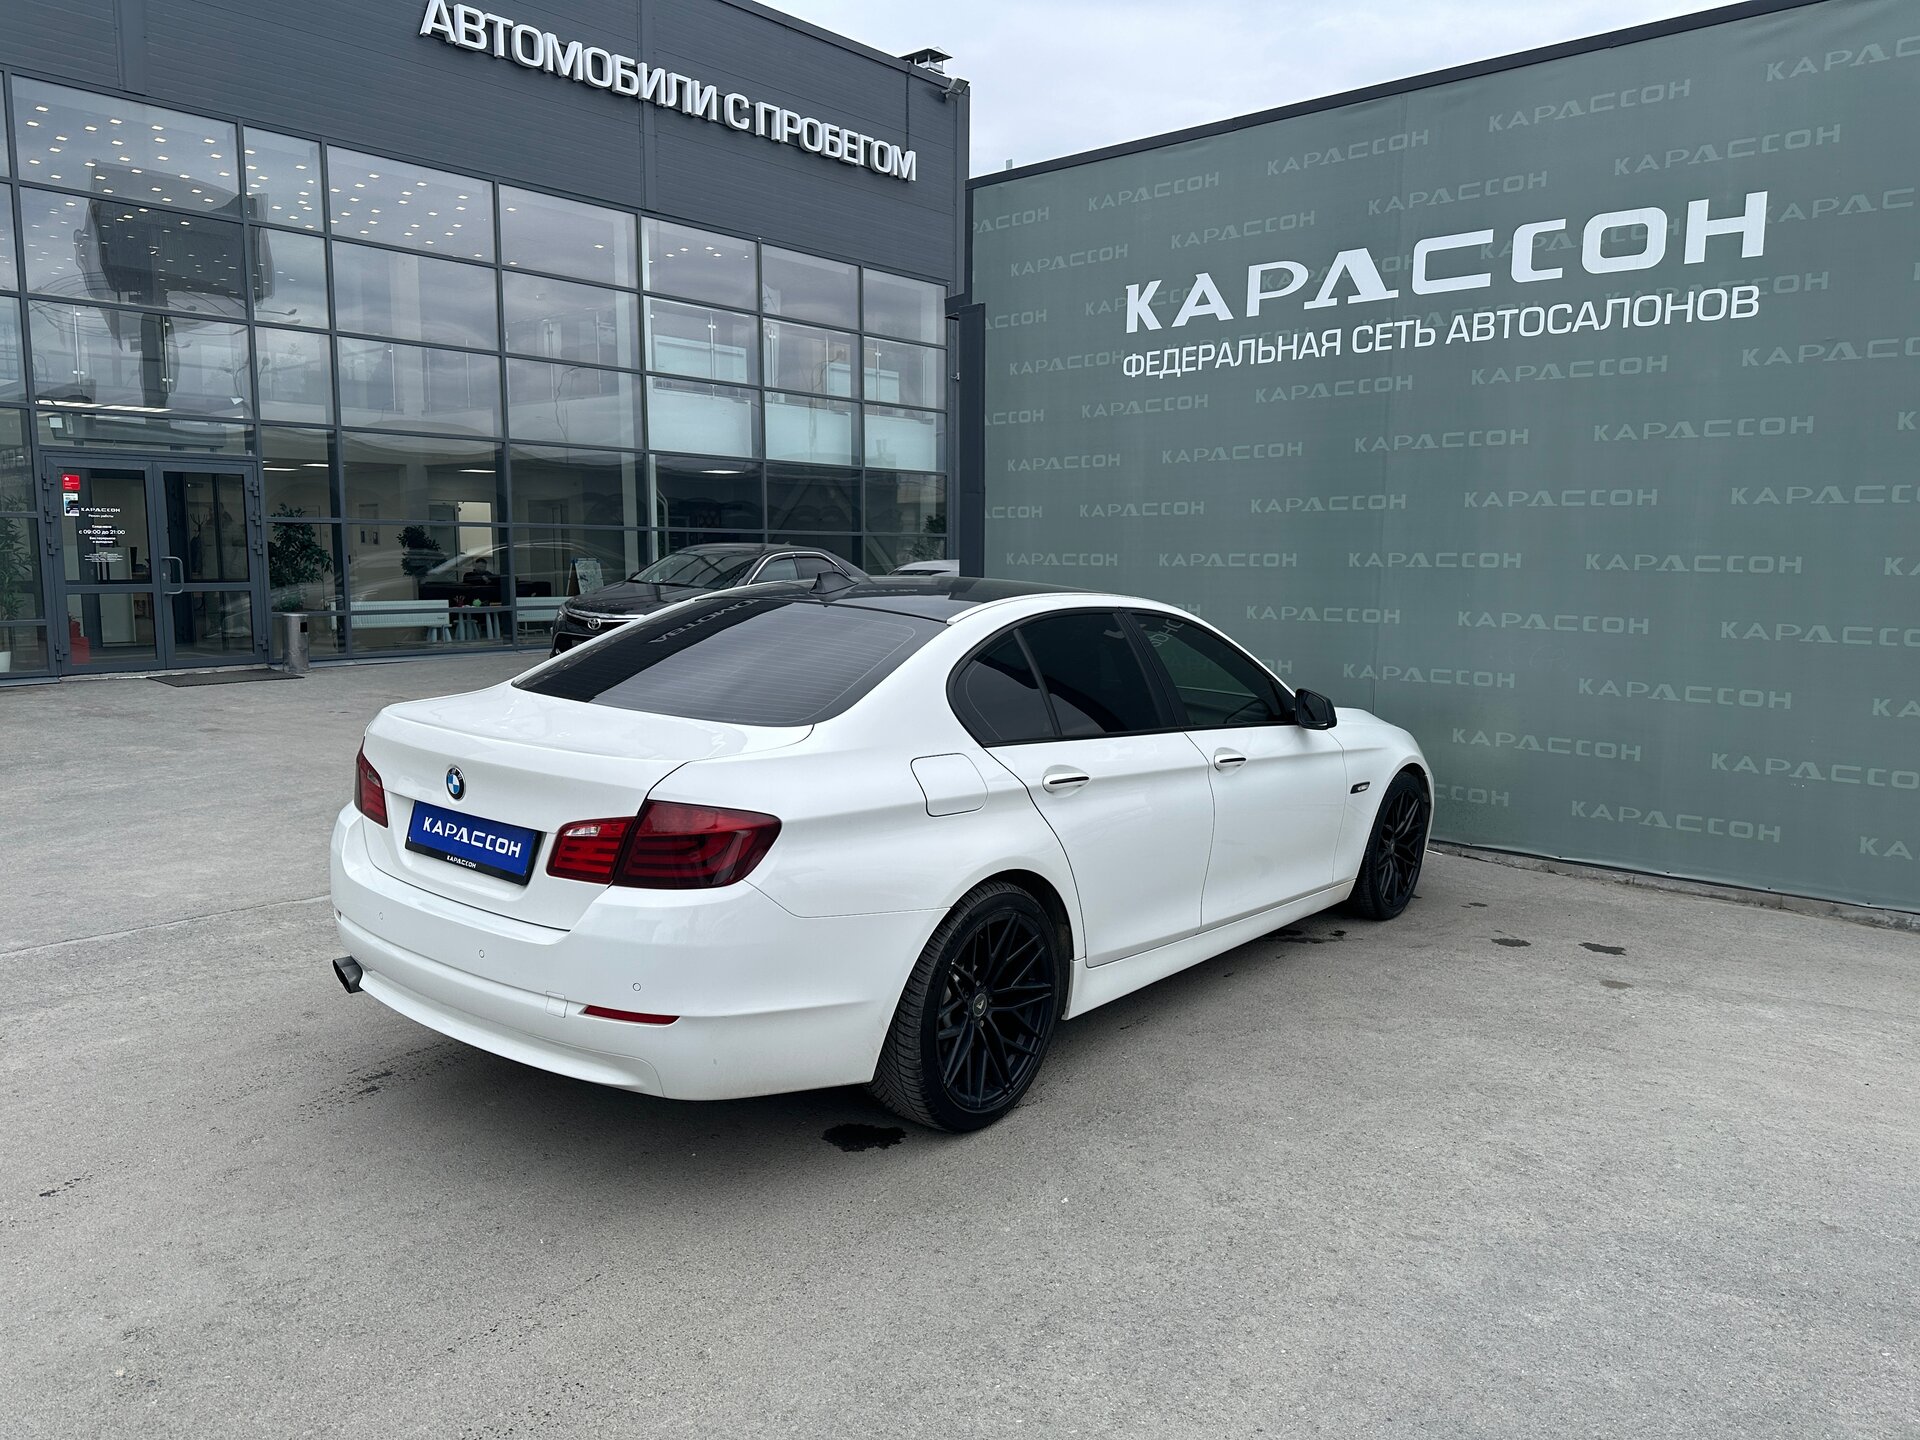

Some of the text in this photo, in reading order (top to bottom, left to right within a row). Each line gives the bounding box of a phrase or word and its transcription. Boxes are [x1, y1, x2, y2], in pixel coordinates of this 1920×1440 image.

[418, 0, 917, 182] АВТОМОБИЛИ С ПРОБЕГОМ
[1122, 328, 1342, 380] ФЕДЕРАЛЬНАЯ
[1351, 319, 1436, 354] СЕТЬ
[1444, 285, 1760, 345] АВТОСАЛОНОВ
